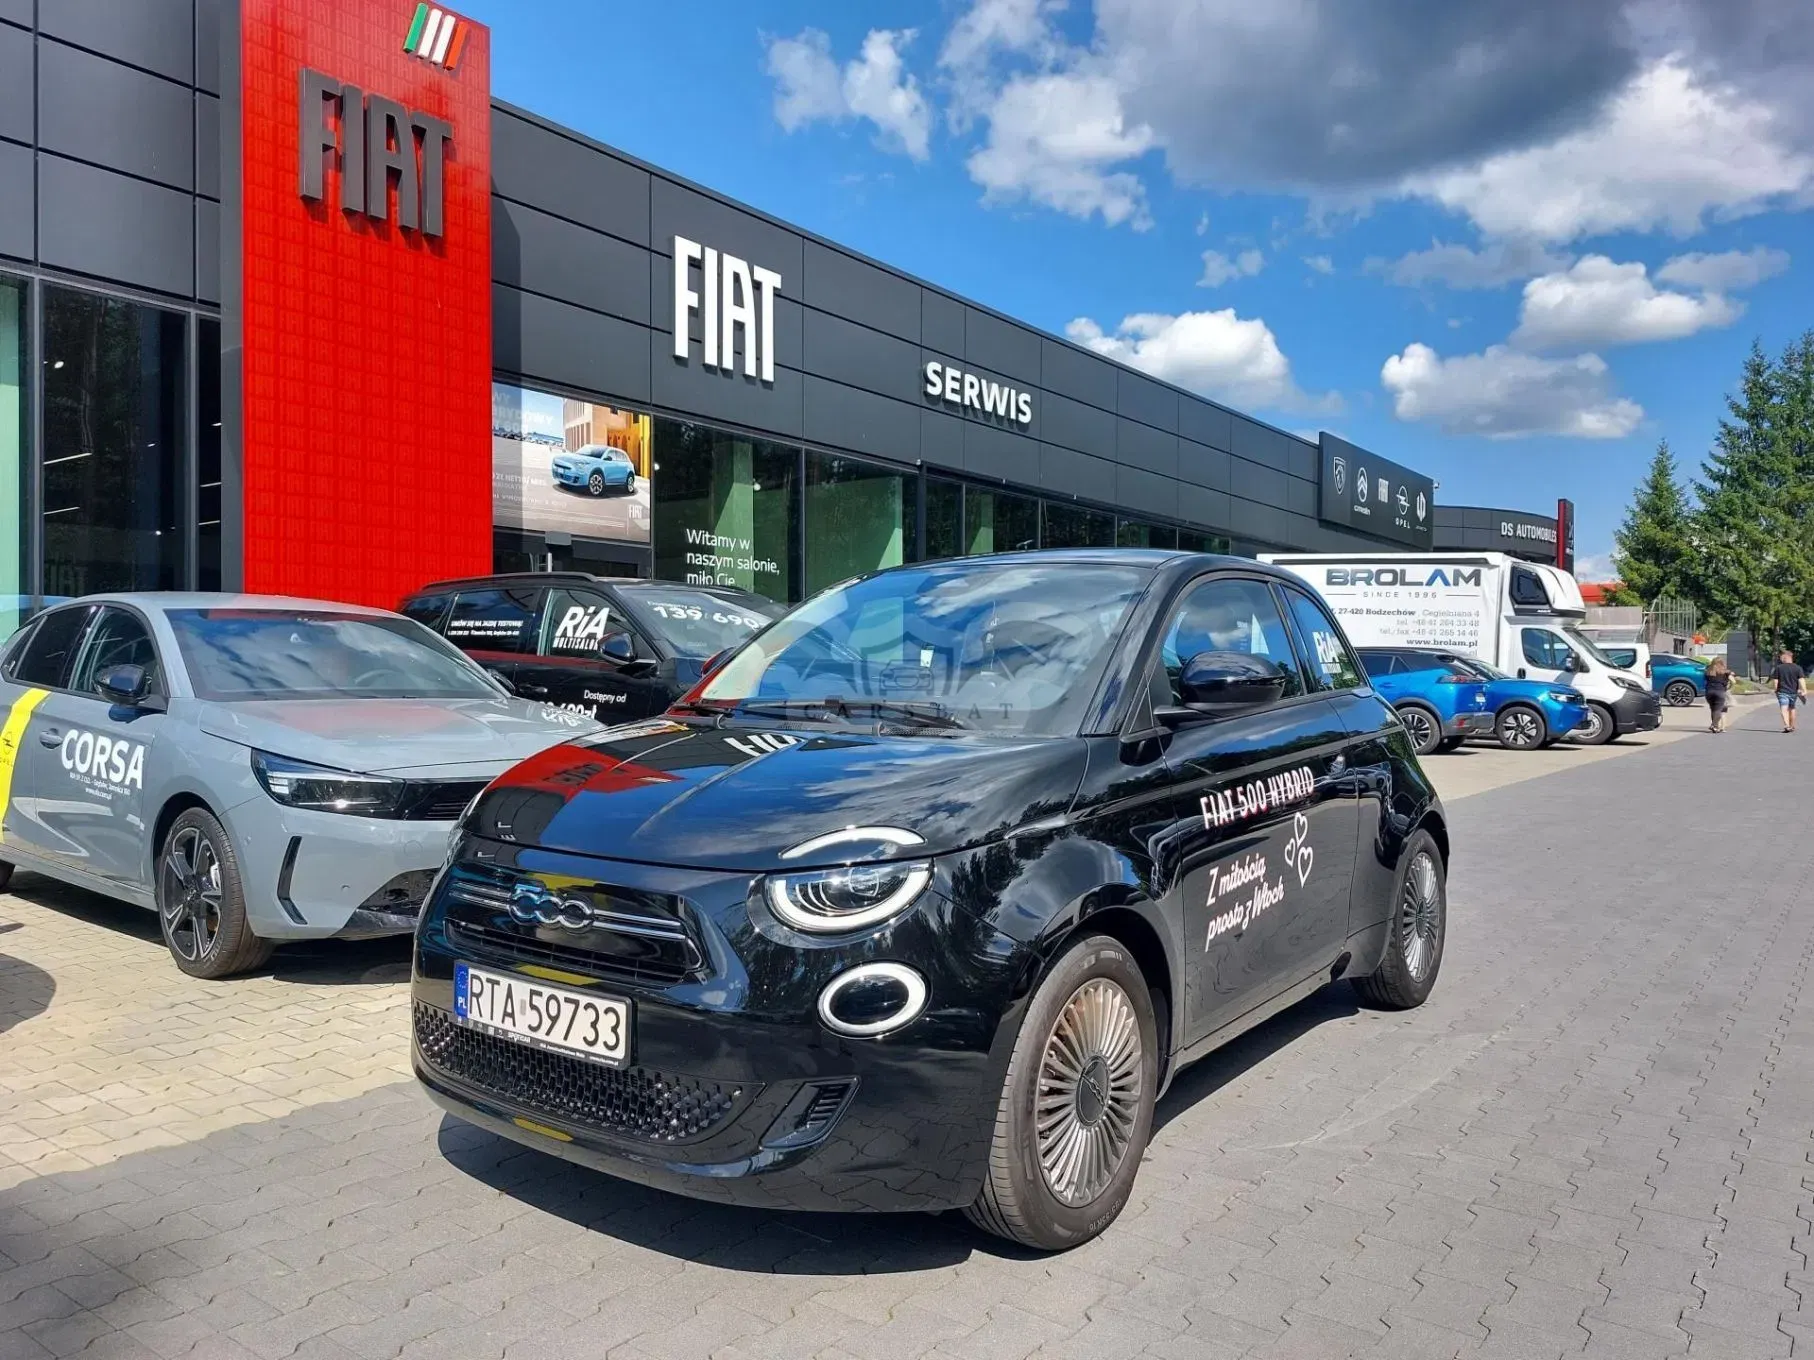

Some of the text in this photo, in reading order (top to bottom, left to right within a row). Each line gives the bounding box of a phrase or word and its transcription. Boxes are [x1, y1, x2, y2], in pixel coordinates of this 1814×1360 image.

[300, 68, 452, 237] FIAT
[674, 235, 782, 382] FIAT
[926, 361, 1032, 424] SERWIS
[629, 504, 643, 519] FIAT
[1395, 517, 1410, 529] OPEL
[686, 529, 750, 552] Witamy w
[1501, 521, 1557, 543] DS AUTOMOBILES
[686, 552, 780, 576] naszym salonie,
[687, 569, 714, 586] miło
[1326, 568, 1481, 587] BROLAM
[554, 606, 610, 640] RiA
[653, 606, 703, 621] 139
[1338, 607, 1364, 615] 27-420
[1365, 607, 1416, 616] Bodzechów
[1406, 638, 1478, 648] www.brolam.pl
[583, 689, 627, 704] Dostępny od
[61, 729, 146, 789] CORSA
[1200, 766, 1315, 830] FIAT 500 HYBRID
[1206, 852, 1266, 907] Z miłością
[1205, 875, 1285, 952] prosto z Włoch
[457, 996, 467, 1009] PL
[470, 974, 621, 1052] RTA 59733
